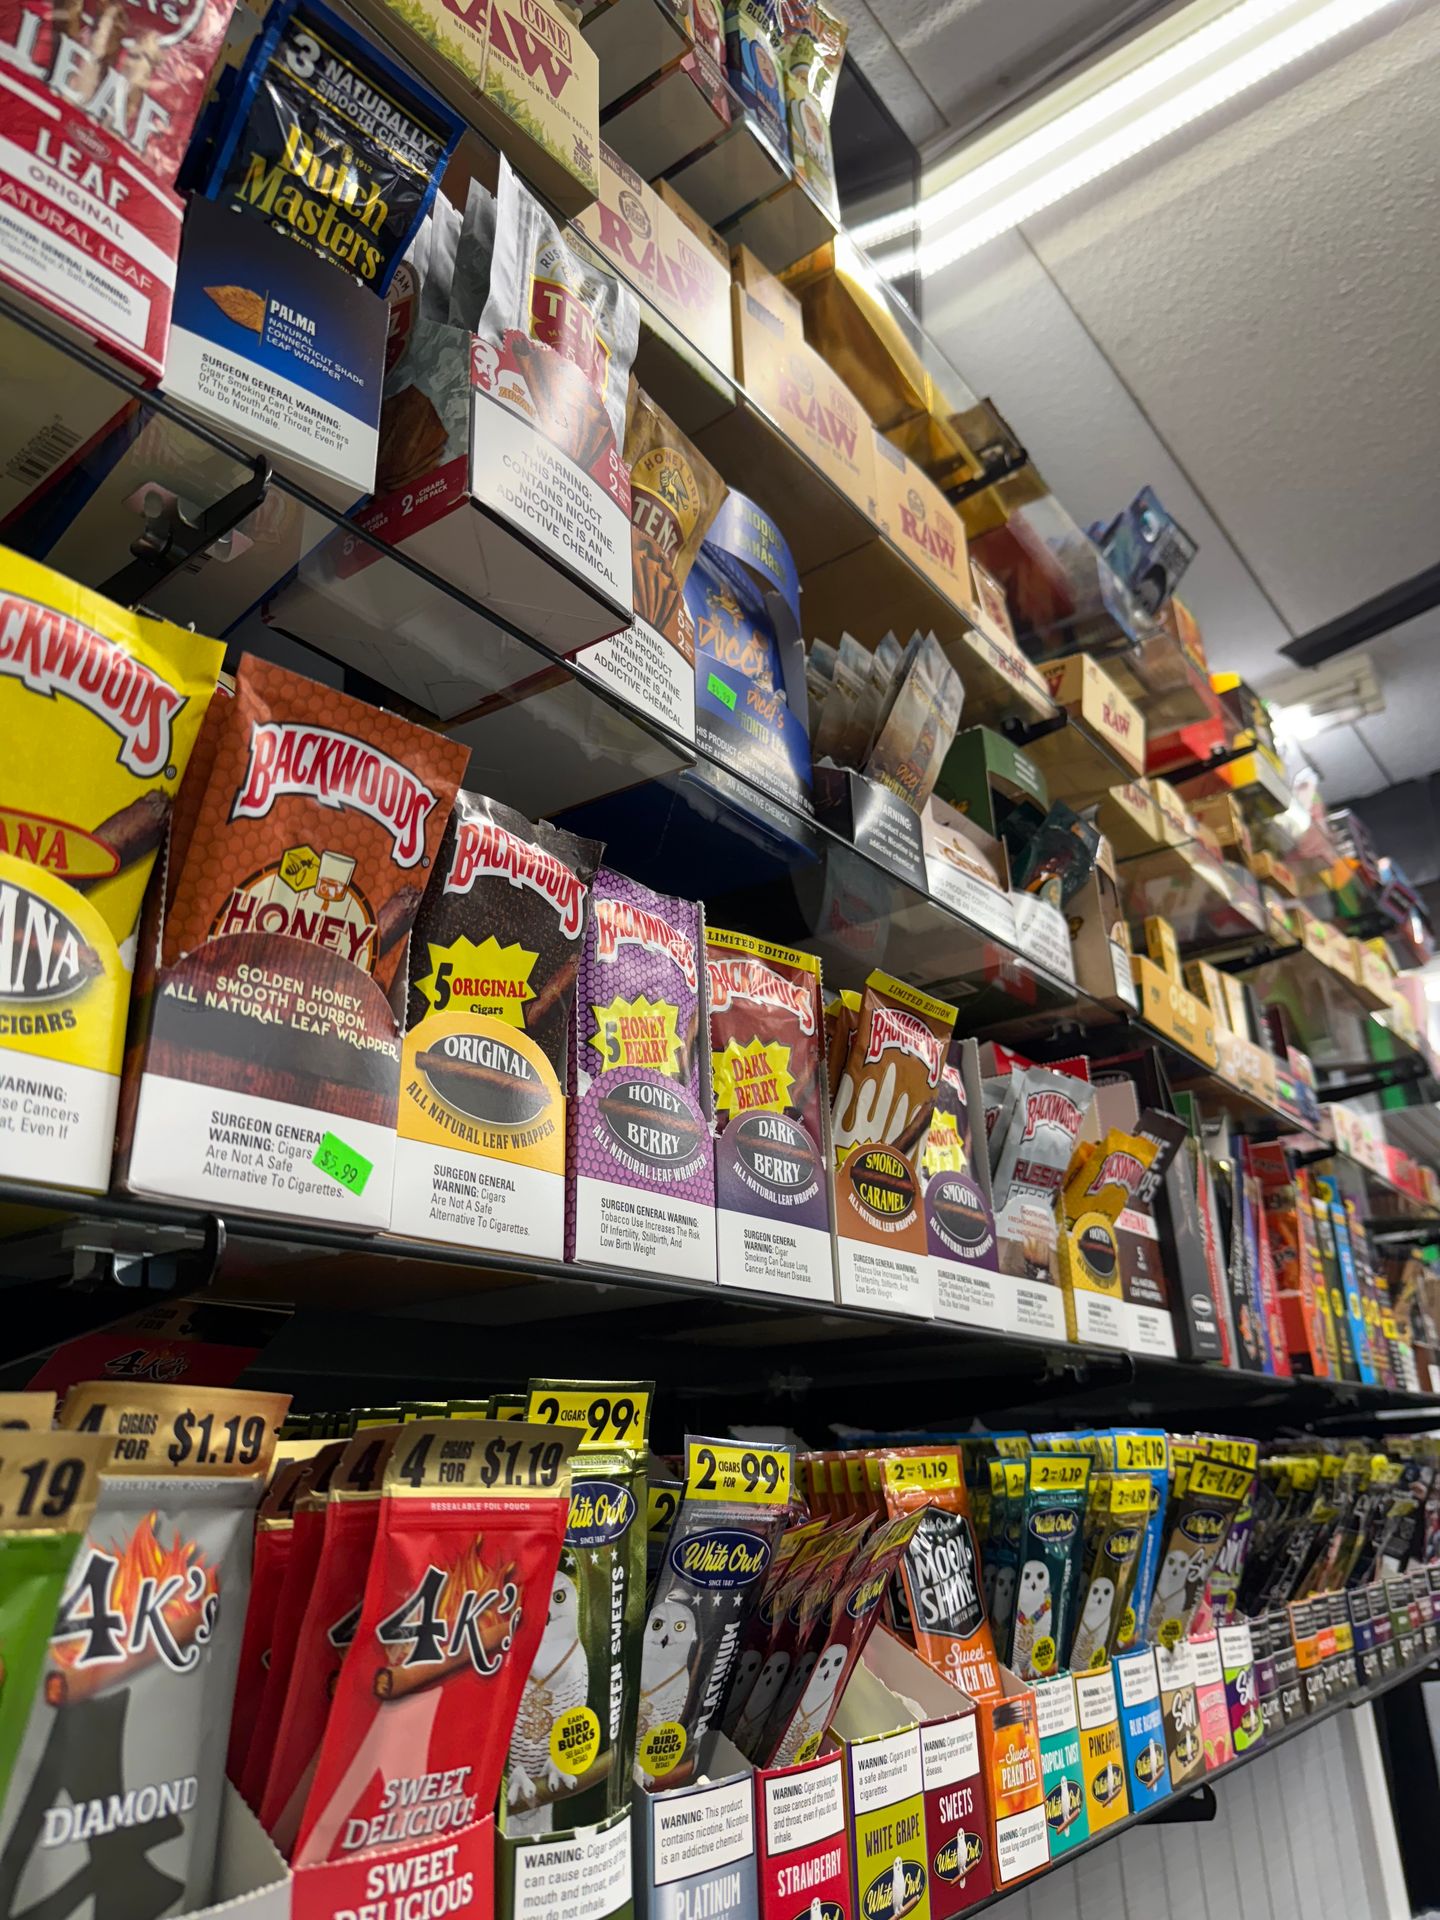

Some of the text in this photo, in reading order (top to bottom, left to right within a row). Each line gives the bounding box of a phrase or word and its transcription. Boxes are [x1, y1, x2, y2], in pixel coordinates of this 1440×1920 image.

[524, 0, 569, 57] CONE
[0, 9, 172, 152] LEAF
[285, 34, 433, 152] 3 NATURALLY
[316, 77, 426, 168] SMOOTH CIGARS
[36, 128, 129, 209] LEAF
[279, 123, 388, 236] Dutch
[28, 164, 124, 240] ORIGINAL
[236, 151, 382, 281] Masters
[0, 178, 93, 253] ATURAL
[99, 244, 153, 290] LEAF
[596, 201, 714, 313] RAW
[269, 317, 314, 348] NATURAL
[270, 299, 316, 337] PALMA
[266, 335, 342, 381] LEAF WRAPPER
[267, 327, 365, 388] CONNECTICUT SHADE
[202, 353, 342, 432] SURGEON GENERAL WARNING:
[521, 452, 602, 525] THIS PRODUCT
[536, 447, 593, 502] WARNING:
[502, 455, 616, 555] CONTAINS NICOTINE.
[519, 483, 603, 557] NICOTINE IS AN
[633, 495, 679, 558] TENZ
[496, 484, 619, 588] ADDICTIVE CHEMICAL.
[899, 503, 956, 570] RAW
[1102, 703, 1132, 737] RAW
[233, 722, 435, 865] BACKWOODS
[445, 820, 588, 938] BACKWOODS
[221, 888, 377, 960] HONEY
[595, 900, 699, 993] BACKWOODS
[707, 930, 801, 964] LIMITED EDITION
[164, 982, 198, 1003] ALL
[205, 992, 283, 1025] NATURAL
[291, 1014, 330, 1036] LEAF
[216, 976, 368, 1032] SMOOTH BOURBON.
[237, 964, 364, 1014] GOLDEN HONEY.
[433, 963, 528, 1011] 5 ORIGINAL
[470, 1003, 504, 1016] Cigars
[709, 960, 816, 1036] BACKWOODS
[887, 984, 950, 1018] LIMITED EDITION
[443, 1036, 532, 1081] ORIGINAL
[604, 1016, 666, 1063] 5 HONEY
[625, 1038, 669, 1064] BERRY
[868, 1008, 945, 1087] BACKWOODS
[731, 1052, 772, 1082] DARK
[23, 1100, 80, 1124] Cancers
[405, 1080, 556, 1150] ALL NATURAL LEAF WRAPPER
[628, 1085, 682, 1114] HONEY
[735, 1079, 780, 1111] BERRY
[209, 1127, 313, 1161] WARNING: Cigars
[211, 1110, 325, 1145] SURGEON GENERA
[627, 1122, 681, 1156] BERRY
[758, 1119, 796, 1146] DARK
[320, 1149, 358, 1185] $5.99
[592, 1123, 708, 1183] ALL NATURAL LEAF WRAPPER
[754, 1152, 801, 1184] BERRY
[865, 1154, 904, 1179] SMOKED
[202, 1162, 345, 1200] Alternative To Cigarettes.
[433, 1165, 516, 1192] SURGEON GENERAL
[859, 1182, 906, 1212] CARAMEL
[942, 1184, 978, 1209] SMOOTH
[115, 1409, 265, 1466] FOR $1.19
[118, 1412, 158, 1435] CIGARS
[537, 1397, 640, 1441] 2 CIGARS 99¢
[347, 1440, 385, 1491] 4
[401, 1433, 435, 1487] 4
[439, 1436, 563, 1488] FOR $1.19
[440, 1440, 474, 1459] CIGARS
[695, 1448, 741, 1490] 2 CIGARS
[894, 1464, 905, 1480] 2
[723, 1452, 785, 1494] FOR 99¢
[1041, 1467, 1050, 1482] 2
[430, 1502, 531, 1511] RESEALABLE FOIL POUCH
[566, 1490, 629, 1530] hite Owl
[684, 1540, 763, 1573] White Owl
[913, 1533, 970, 1590] MOON
[48, 1548, 221, 1673] 4K's
[920, 1567, 977, 1626] SHINE
[376, 1563, 524, 1677] 4K's
[609, 1565, 624, 1740] GREEN SWEETS
[945, 1643, 985, 1666] Sweet
[694, 1621, 741, 1740] PLATINUM
[980, 1662, 995, 1690] TEA
[558, 1729, 595, 1751] BUCKS
[562, 1721, 590, 1739] BIRD
[1089, 1726, 1121, 1758] PINEAPPLE
[1001, 1759, 1037, 1791] PEACH TEA
[1005, 1743, 1031, 1763] Sweet
[380, 1766, 472, 1810] SWEET
[939, 1787, 973, 1824] SWEETS
[42, 1776, 198, 1847] DIAMOND
[661, 1800, 743, 1831] WARNING: This product
[524, 1842, 608, 1869] WARNING: Cigar
[864, 1813, 921, 1858] WHITE GRAPE
[937, 1835, 981, 1874] White Owl
[365, 1845, 459, 1900] SWEET
[778, 1848, 841, 1898] STRAWBERRY
[867, 1869, 922, 1913] White Owl
[675, 1872, 741, 1920] PLATINUM
